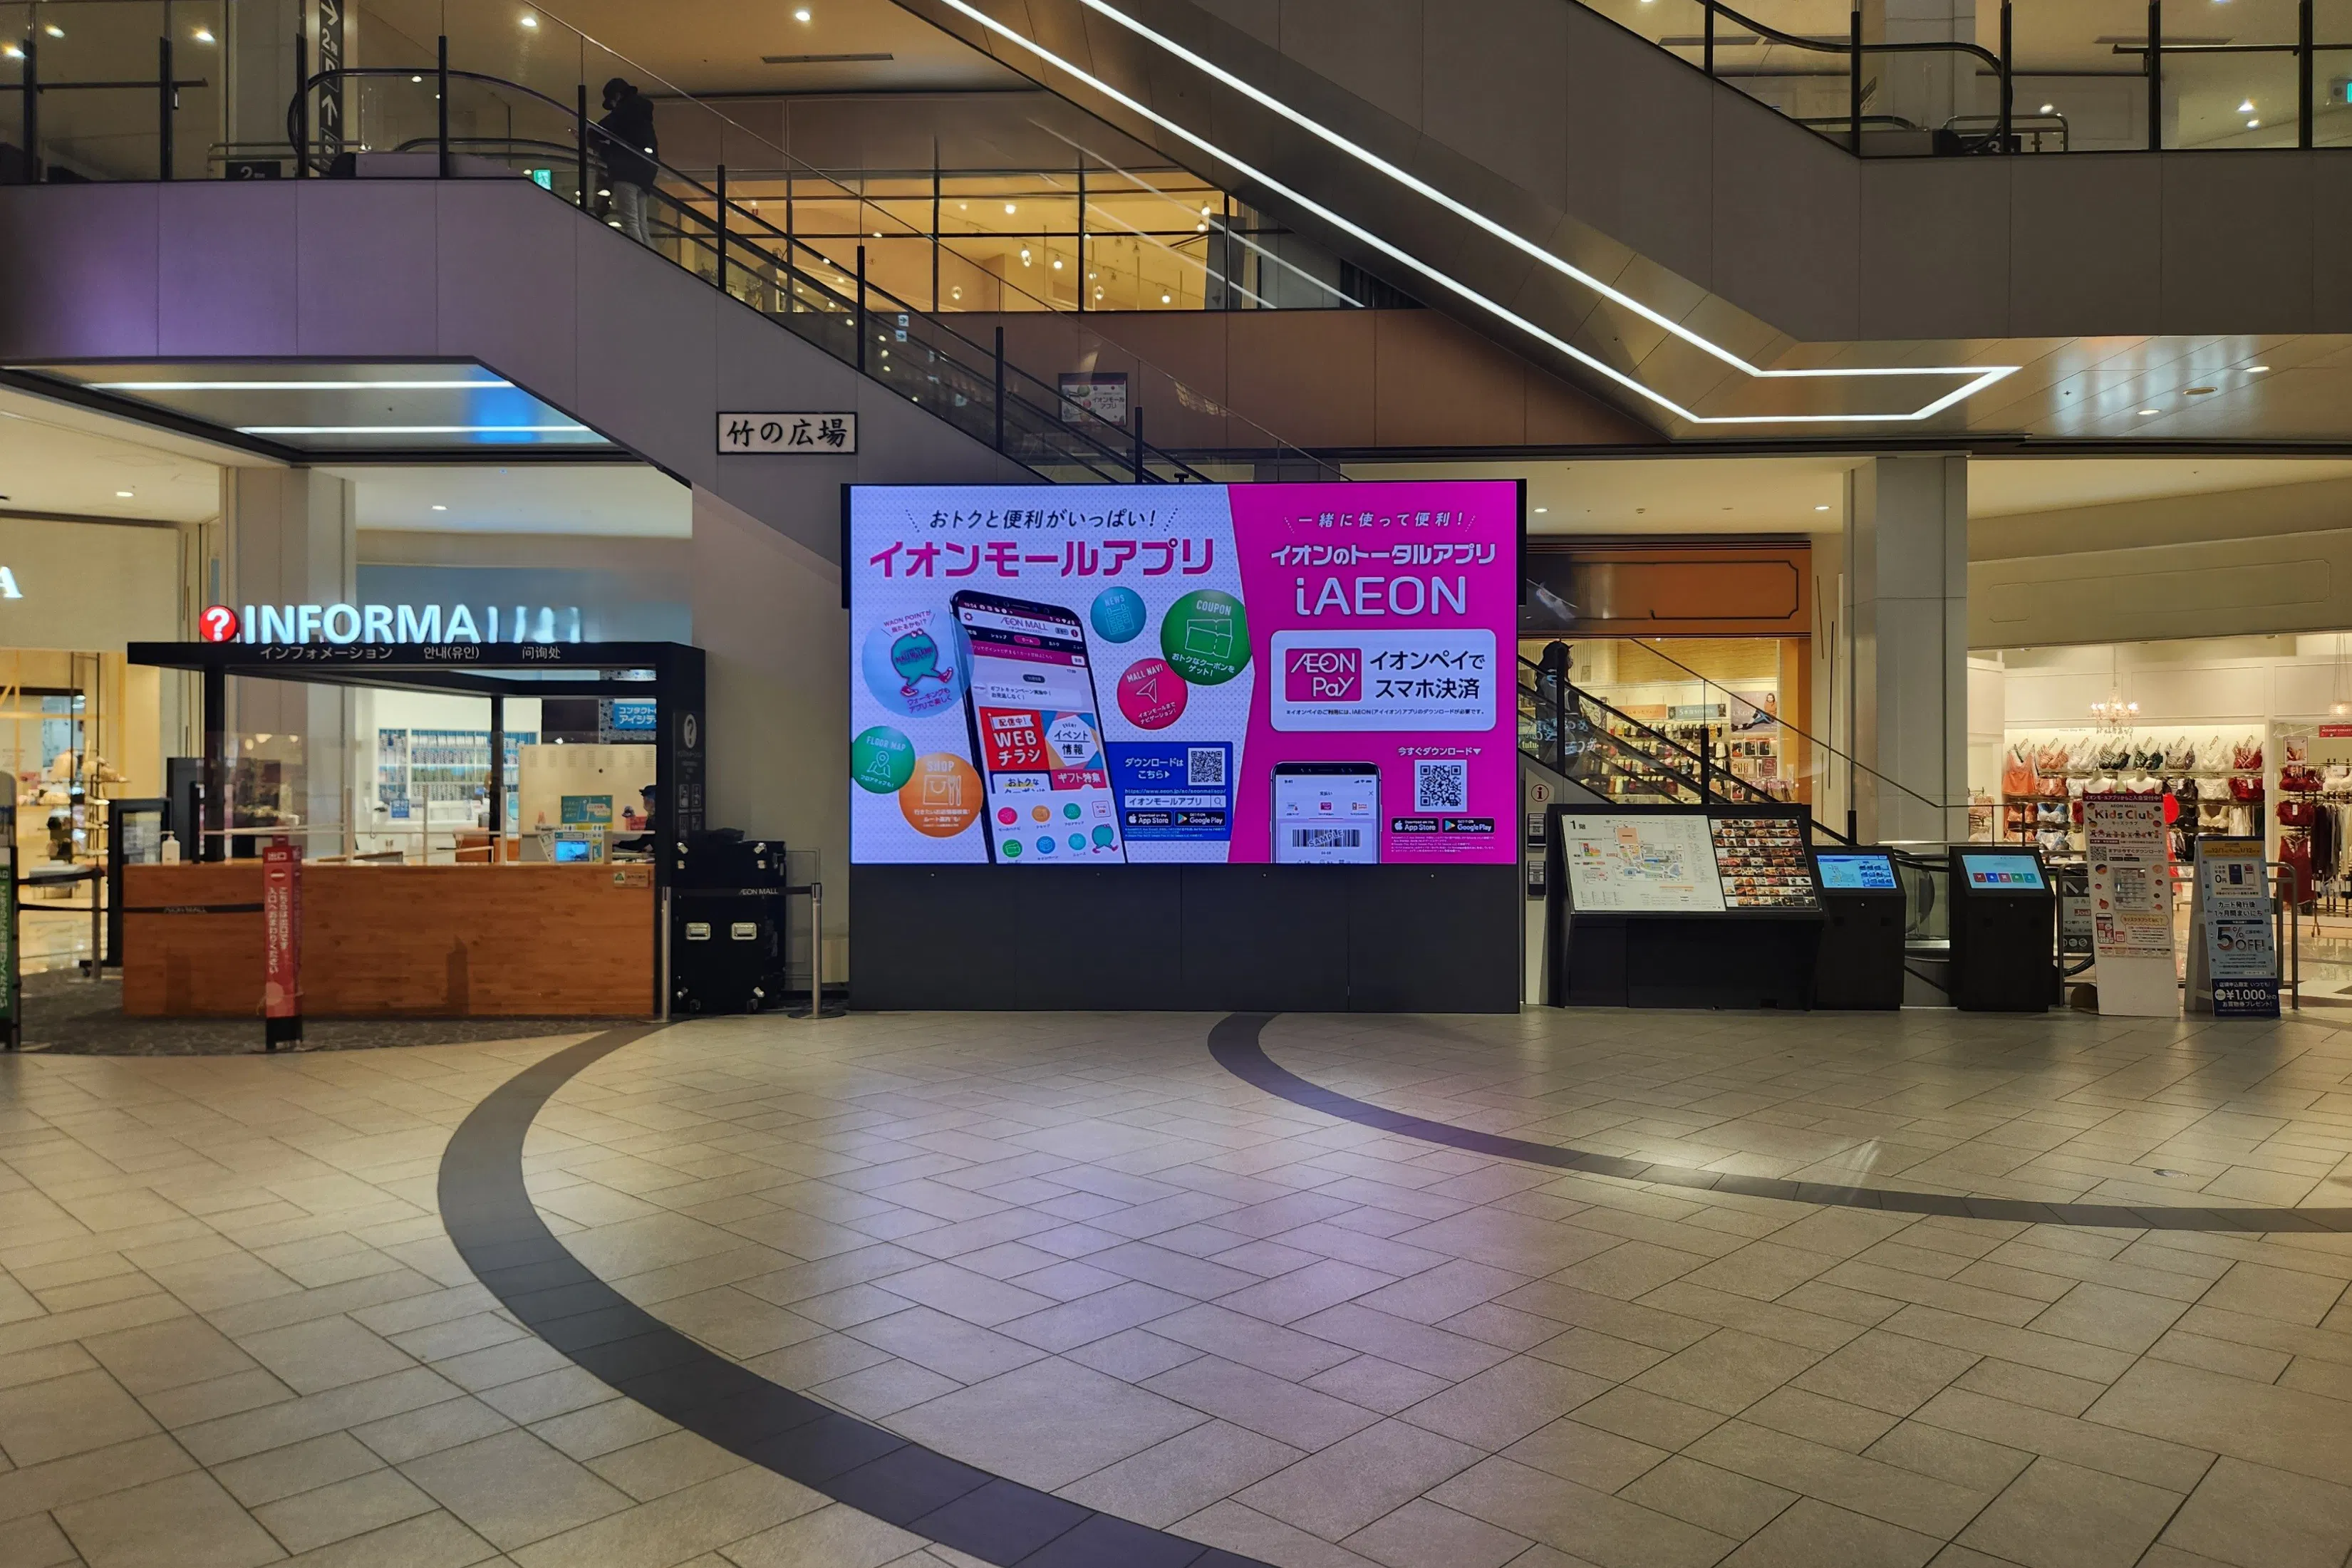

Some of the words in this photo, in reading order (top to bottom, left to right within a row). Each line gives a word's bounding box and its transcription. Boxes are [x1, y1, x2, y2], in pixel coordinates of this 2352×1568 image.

[727, 418, 848, 447] 竹の広場
[870, 538, 1213, 578] イオンモールアプリ
[1271, 544, 1495, 566] イオンのトータルアプリ
[1104, 595, 1125, 606] NEWS
[1296, 576, 1466, 616] iAEON
[1196, 600, 1232, 616] COUPON
[1025, 621, 1048, 630] MALL
[260, 647, 393, 660] インフォメーション
[522, 647, 561, 660] 问询处
[1370, 650, 1486, 671] イオンペイで
[1171, 653, 1235, 673] おトクなクーポンを
[1126, 671, 1146, 682] MALL
[1146, 664, 1163, 677] NAVI
[1375, 677, 1480, 699] スマホ決済
[993, 730, 1037, 748] WEB
[1055, 730, 1089, 741] イベント
[866, 737, 889, 748] FLOOR
[891, 742, 906, 752] MAP
[1062, 744, 1084, 756] 情報
[998, 749, 1040, 767] チラシ
[1125, 757, 1183, 767] ダウンロードは
[927, 760, 955, 772] SHOP
[1008, 778, 1040, 786] おトクな
[1057, 772, 1102, 784] ギフト特集
[1129, 797, 1202, 806] イオンモールアプリ
[2095, 809, 2123, 819] Kids
[2125, 809, 2154, 819] Club
[1308, 829, 1344, 847] SAMPLE
[2214, 875, 2227, 883] 0円
